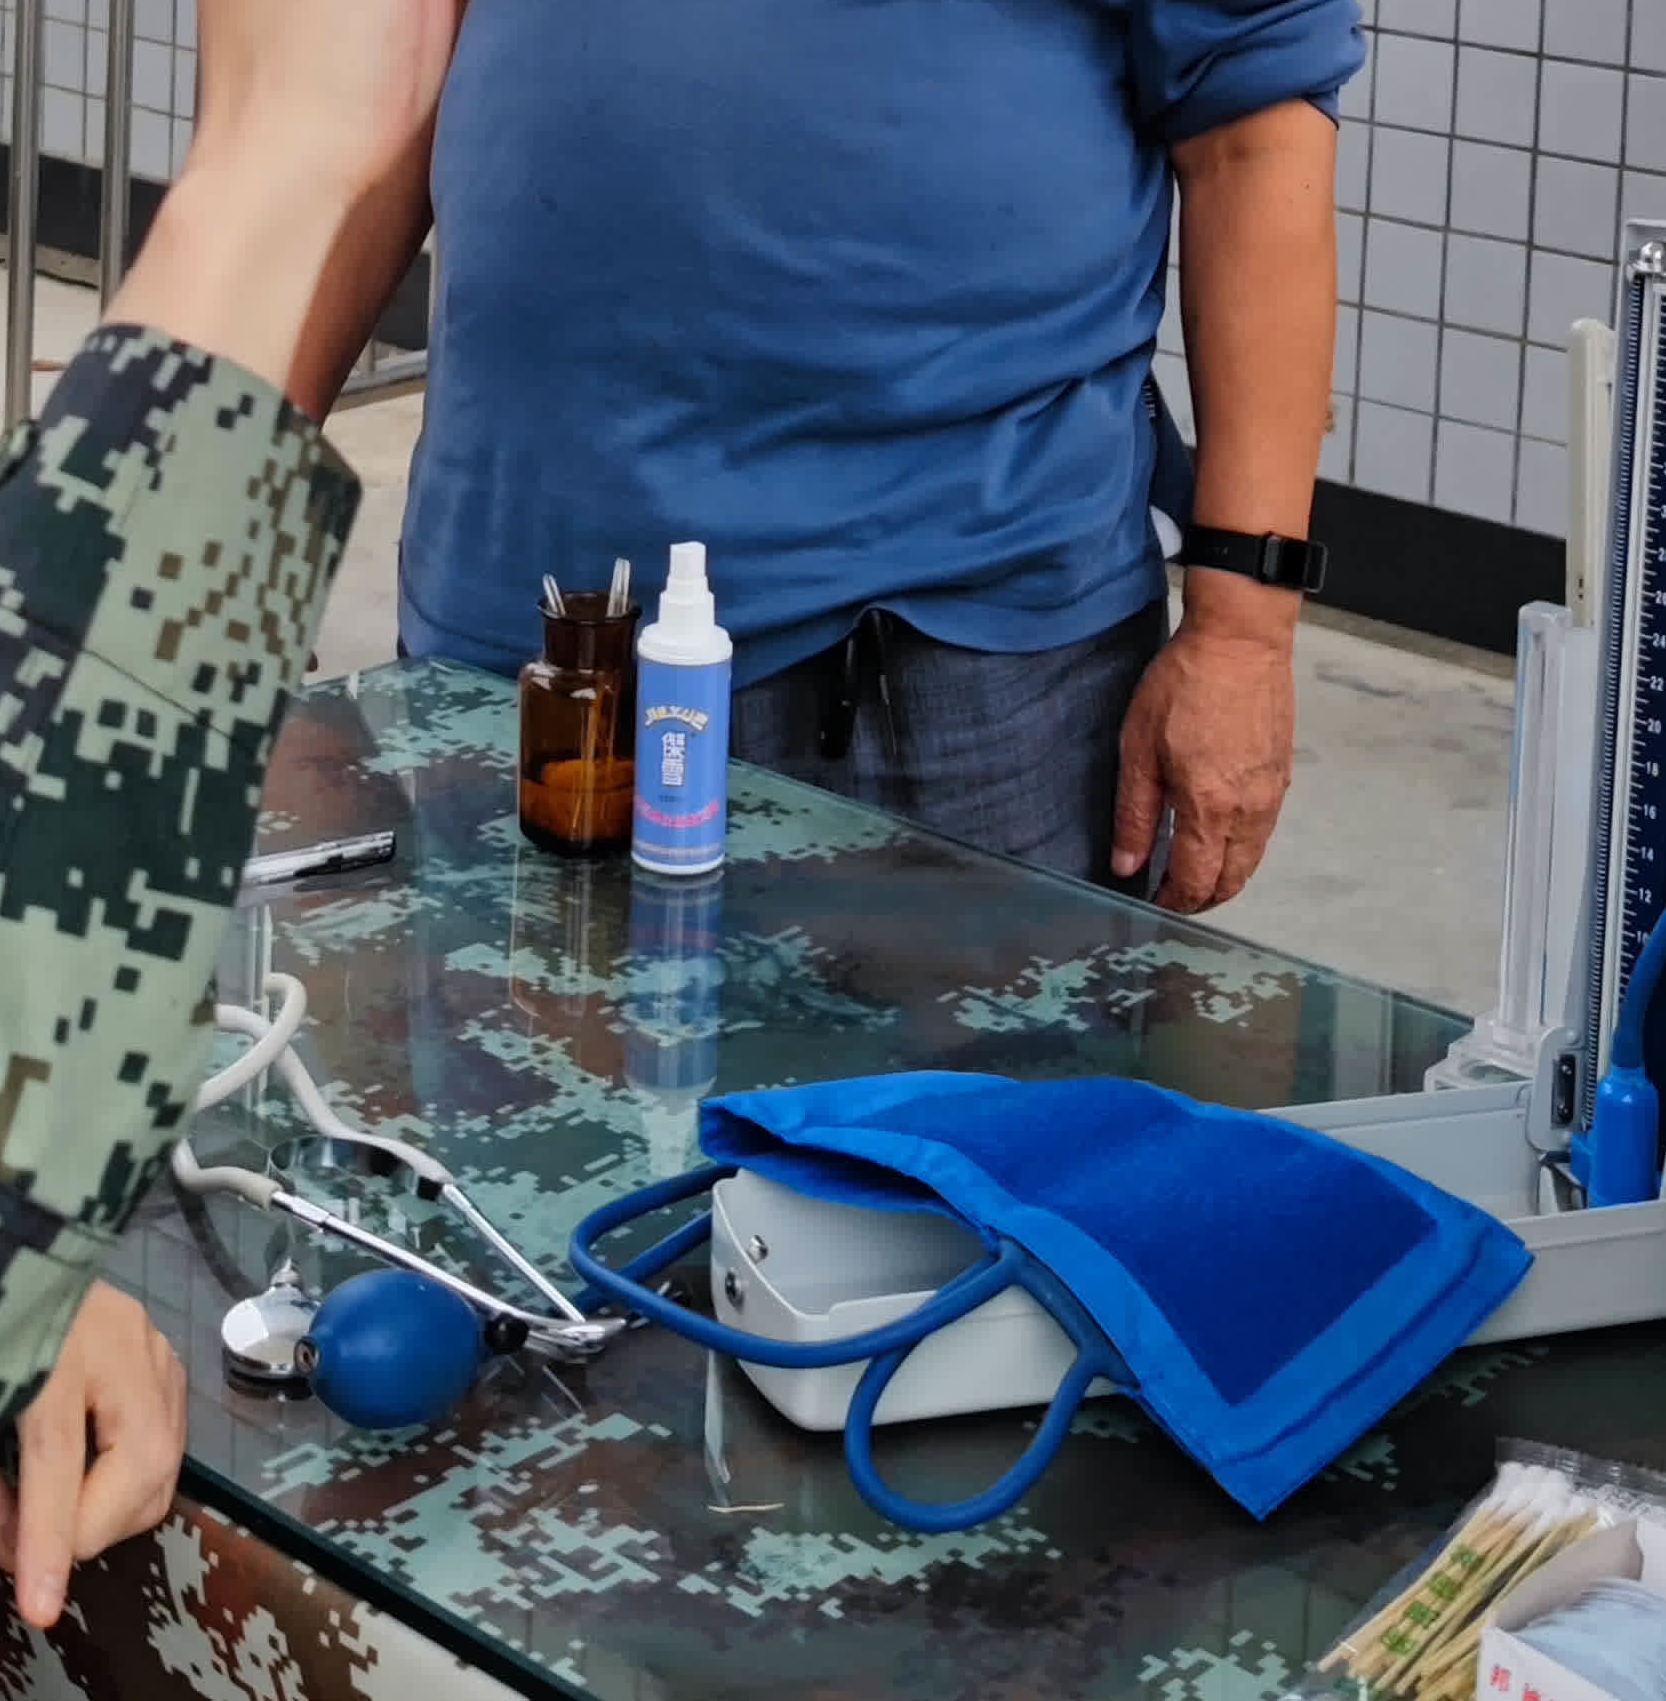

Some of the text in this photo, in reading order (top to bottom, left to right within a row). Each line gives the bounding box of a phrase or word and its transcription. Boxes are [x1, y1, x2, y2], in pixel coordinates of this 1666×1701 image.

[1653, 634, 1666, 649] 24
[1650, 676, 1664, 691] 22
[1648, 719, 1661, 734] 20
[1643, 805, 1657, 819] 16
[1641, 847, 1654, 862] 14
[1638, 888, 1652, 903] 12
